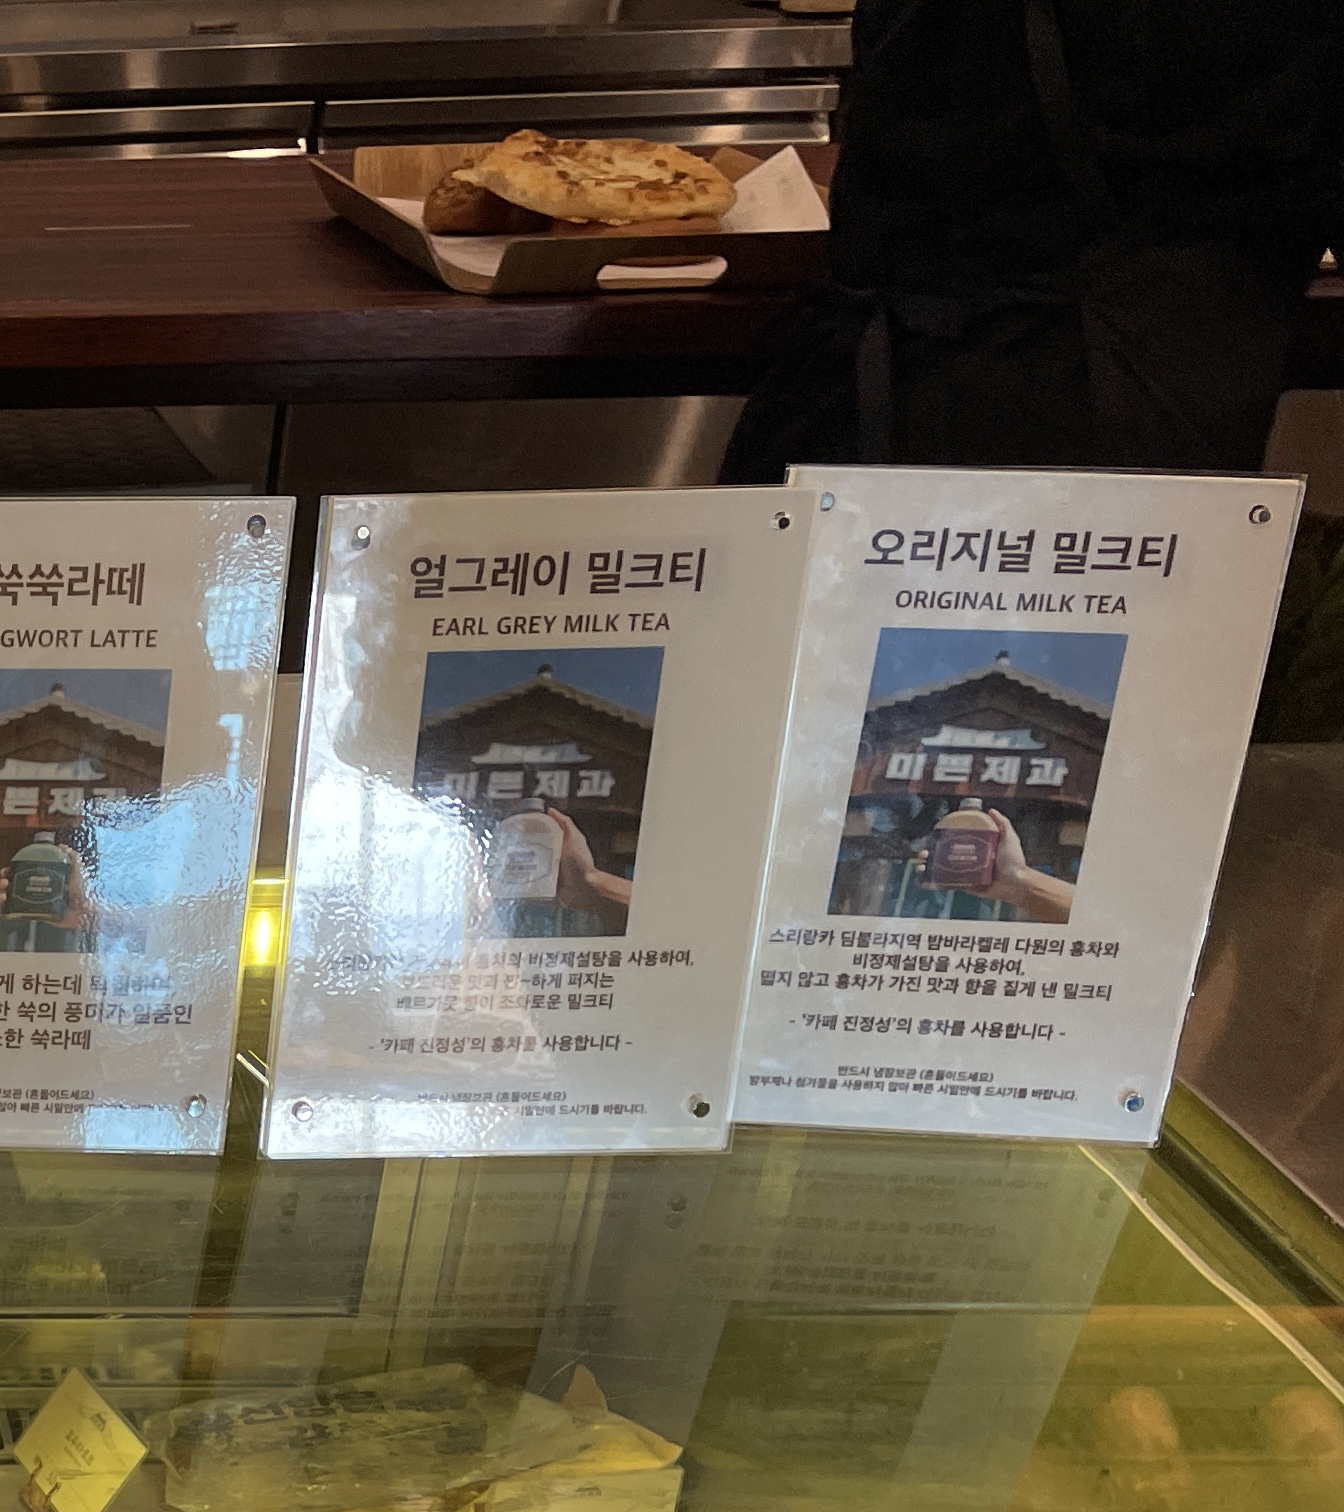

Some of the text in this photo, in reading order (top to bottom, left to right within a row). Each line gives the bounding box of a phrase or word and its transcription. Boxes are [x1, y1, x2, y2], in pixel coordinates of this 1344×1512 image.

[864, 527, 1179, 578] 오리지널 밀크티
[411, 548, 706, 598] 얼그레이 밀크티
[895, 590, 1128, 614] ORIGINAL MILK TEA
[432, 613, 670, 636] EARL GREY MILK TEA
[90, 629, 159, 648] LATTE
[768, 928, 835, 946] 스리랑카
[853, 952, 951, 972] 비정제설탕을
[21, 973, 82, 996] 하는데
[567, 971, 615, 990] 퍼지는
[889, 975, 921, 993] 가진
[926, 976, 959, 995] 맛과
[1063, 981, 1113, 1001] 밀크티
[17, 1001, 56, 1022] 쑥의
[63, 1001, 125, 1023] 풍미가
[567, 992, 613, 1011] 밀크티
[30, 1029, 91, 1050] 쑥라떼
[970, 1019, 1053, 1041] 사용합니다
[542, 1034, 621, 1053] 사용합니다
